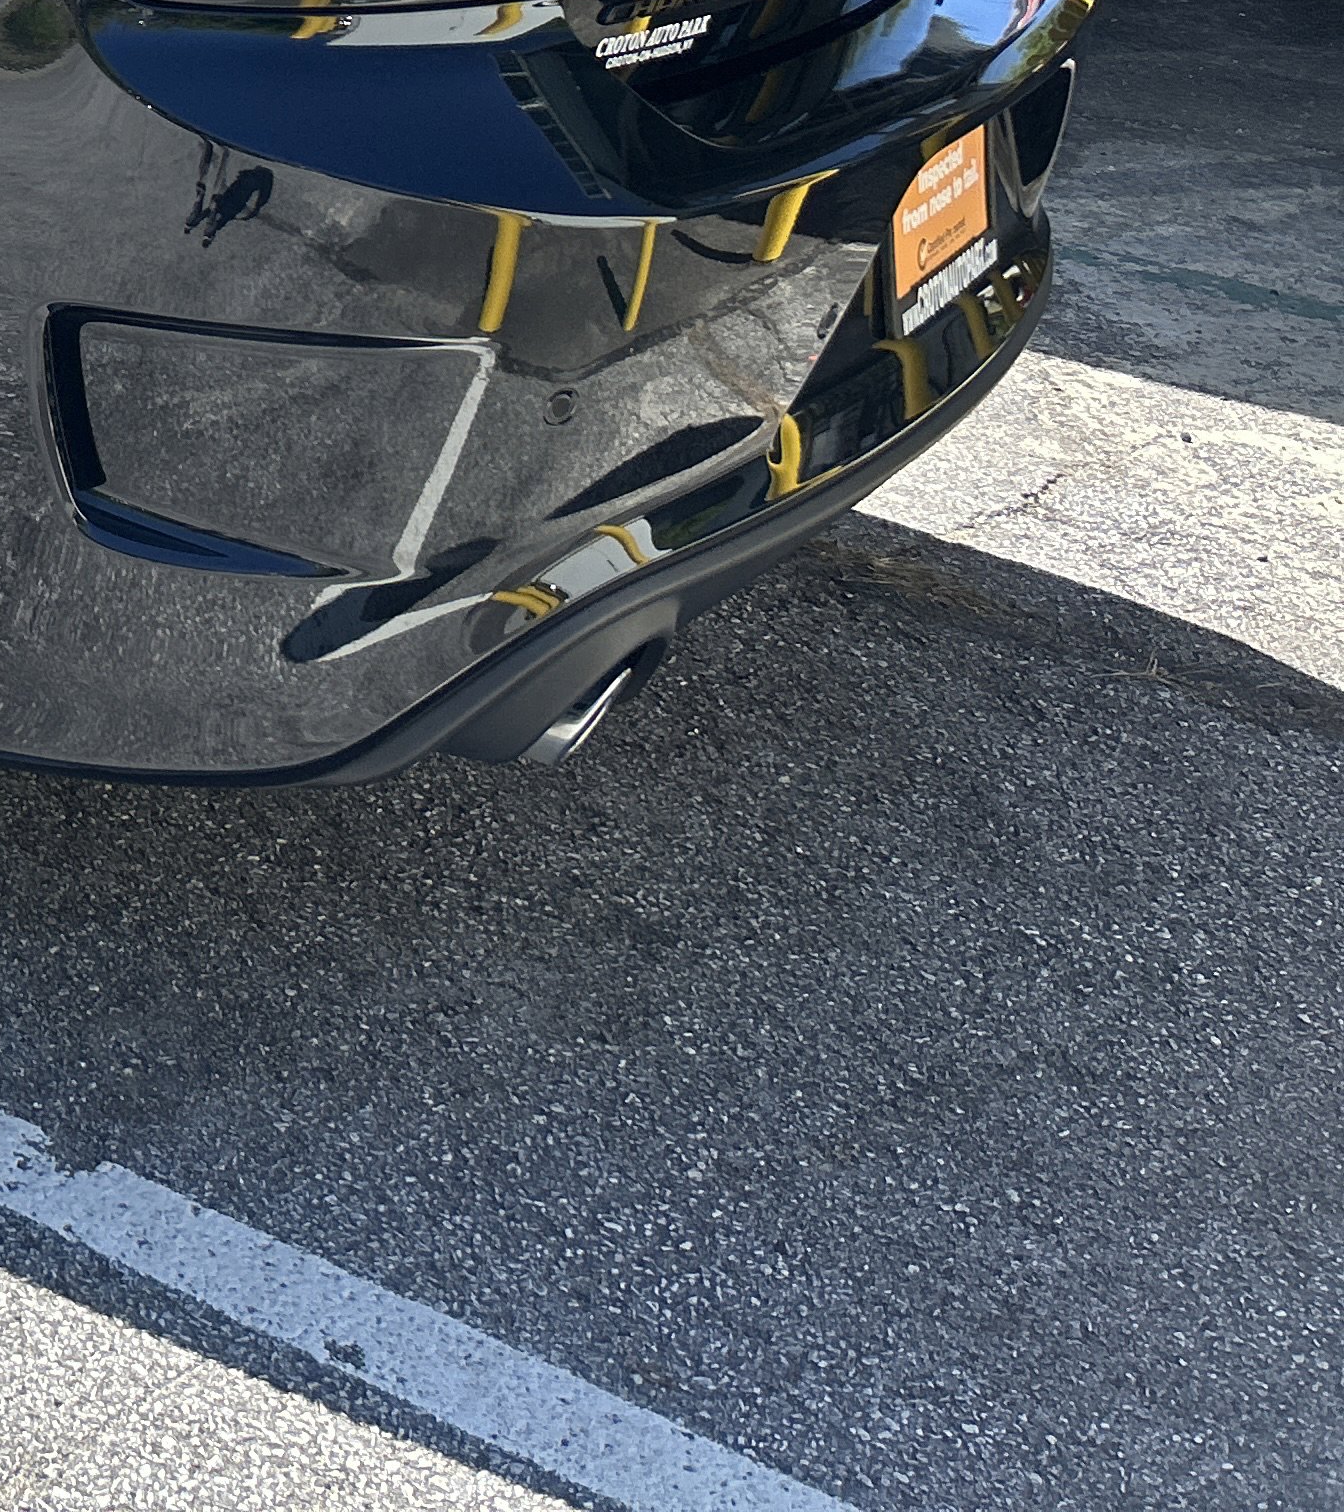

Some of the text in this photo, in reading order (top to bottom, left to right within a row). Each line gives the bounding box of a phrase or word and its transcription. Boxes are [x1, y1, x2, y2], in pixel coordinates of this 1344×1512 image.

[596, 14, 712, 58] CROTON AUTO PARK
[901, 201, 929, 236] from
[929, 185, 953, 218] nose
[953, 176, 964, 199] to
